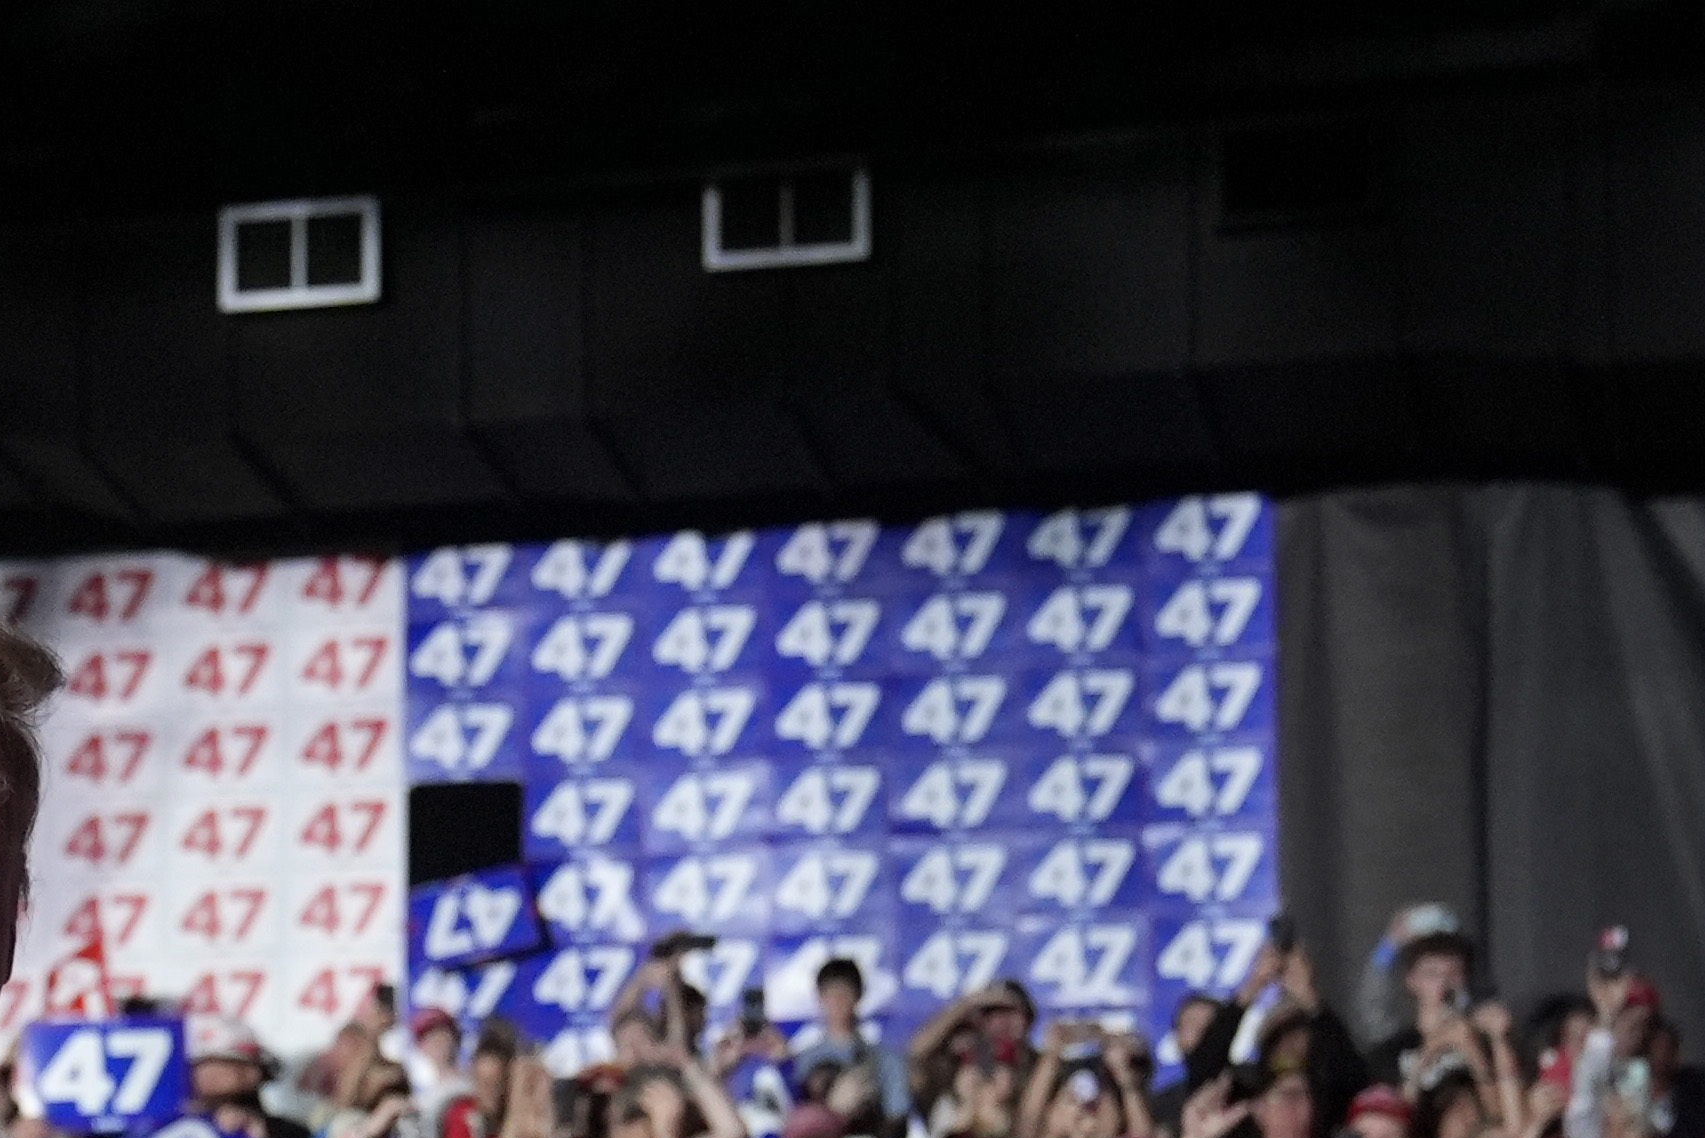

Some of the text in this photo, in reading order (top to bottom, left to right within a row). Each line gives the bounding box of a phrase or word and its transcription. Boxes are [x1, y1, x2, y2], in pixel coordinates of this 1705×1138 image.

[777, 523, 875, 583] 47
[901, 514, 1002, 576] 47
[1028, 508, 1129, 567] 47
[1156, 494, 1260, 563] 47
[70, 568, 155, 623] 47
[187, 563, 269, 614] 47
[303, 558, 389, 608] 47
[412, 546, 511, 606] 47
[653, 605, 755, 674] 47
[776, 602, 879, 665] 47
[901, 594, 1004, 660] 47
[1027, 586, 1131, 654] 47
[1156, 578, 1261, 647] 47
[69, 649, 153, 701] 47
[186, 642, 272, 694] 47
[303, 636, 391, 689] 47
[411, 613, 514, 685] 47
[532, 615, 632, 682] 47
[532, 697, 633, 765] 47
[653, 688, 756, 755] 47
[775, 682, 879, 748] 47
[903, 676, 1006, 745] 47
[1028, 667, 1132, 738] 47
[1155, 663, 1261, 733] 47
[67, 730, 152, 782] 47
[184, 724, 270, 776] 47
[302, 717, 390, 770] 47
[410, 705, 511, 770] 47
[533, 778, 635, 847] 47
[654, 771, 755, 840] 47
[777, 768, 878, 834] 47
[896, 759, 1006, 828] 47
[1027, 754, 1135, 823] 47
[1155, 746, 1262, 818] 47
[65, 812, 151, 865] 47
[182, 806, 268, 858] 47
[301, 799, 389, 853] 47
[536, 862, 634, 930] 47
[653, 852, 755, 930] 47
[777, 844, 875, 921] 47
[904, 844, 1005, 911] 47
[1027, 841, 1132, 909] 47
[1157, 829, 1263, 903] 47
[65, 895, 149, 943] 47
[182, 888, 268, 940] 47
[300, 882, 389, 934] 47
[535, 947, 635, 1012] 47
[904, 928, 1007, 999] 47
[1159, 919, 1264, 988] 47
[185, 972, 265, 1016] 47
[298, 968, 385, 1014] 47
[40, 1028, 175, 1116] 47
